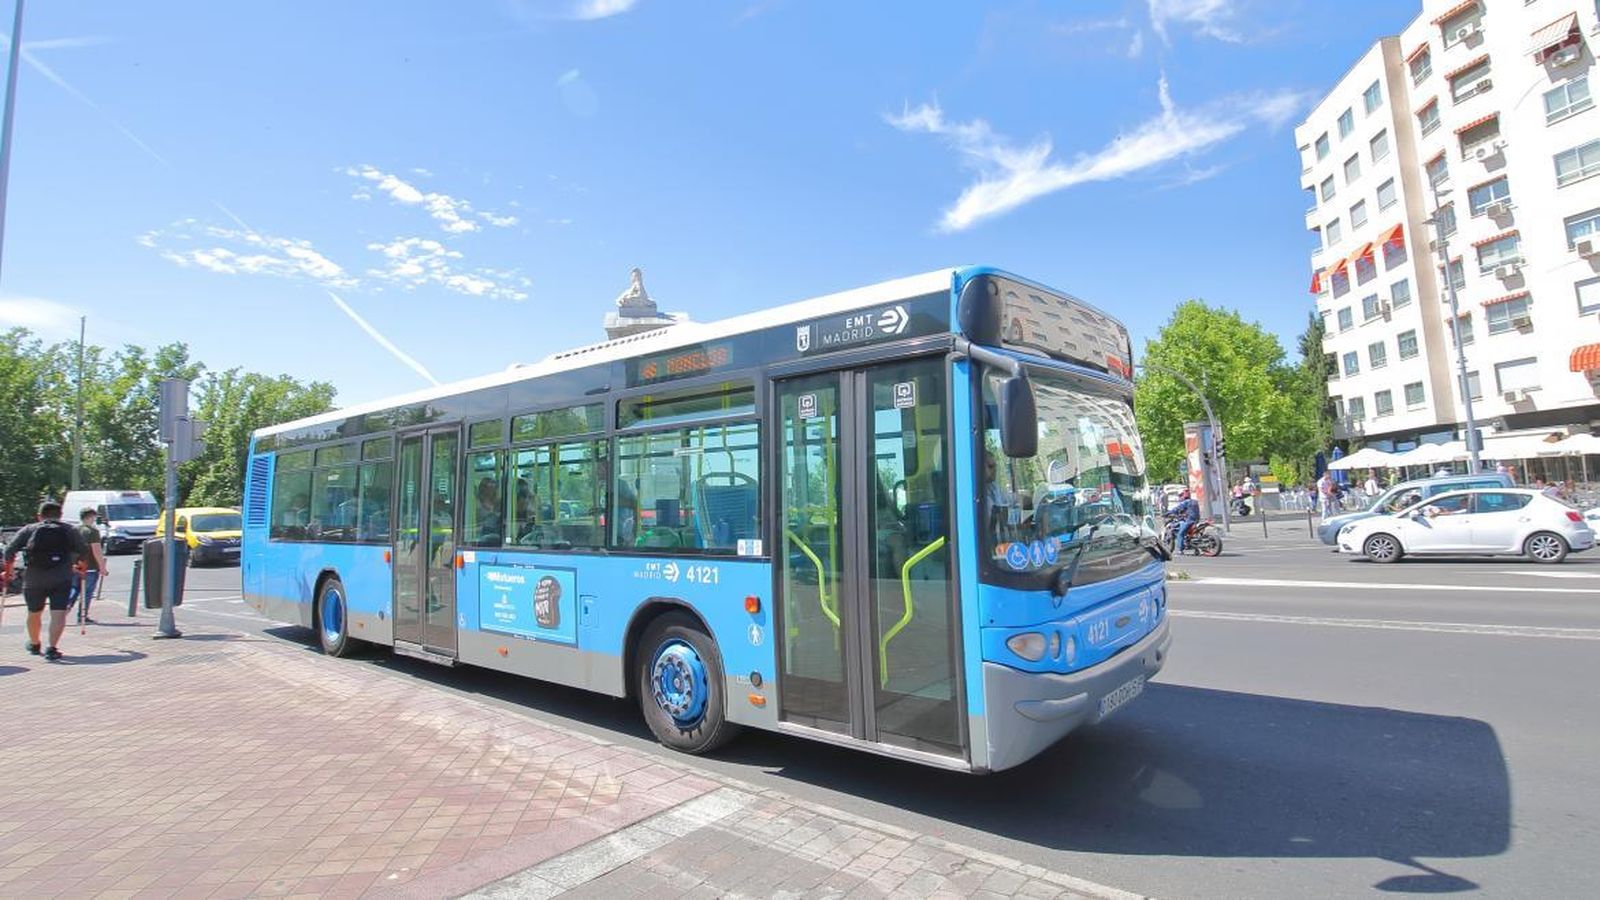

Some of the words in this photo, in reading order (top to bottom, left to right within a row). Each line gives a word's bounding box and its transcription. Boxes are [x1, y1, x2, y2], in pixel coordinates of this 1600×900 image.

[845, 314, 874, 329] EMT
[822, 326, 874, 345] MADRID
[633, 570, 661, 580] MADRID
[645, 562, 661, 571] EMT
[686, 565, 719, 584] 4121
[1088, 618, 1109, 645] 4121
